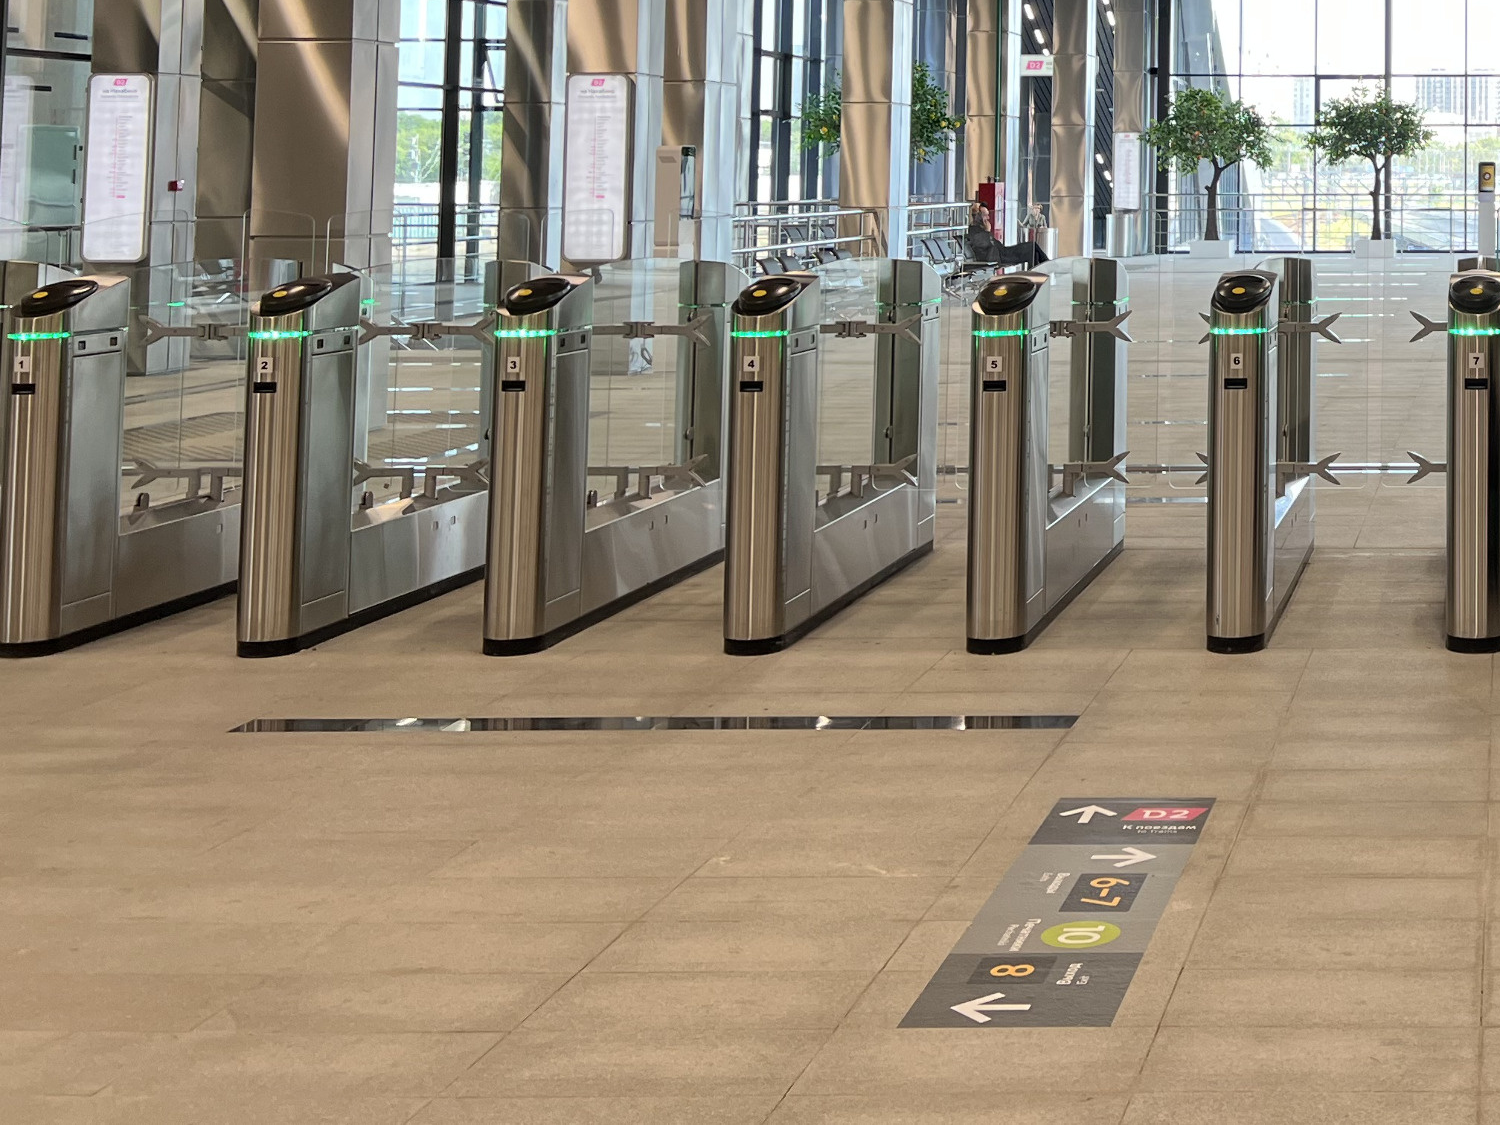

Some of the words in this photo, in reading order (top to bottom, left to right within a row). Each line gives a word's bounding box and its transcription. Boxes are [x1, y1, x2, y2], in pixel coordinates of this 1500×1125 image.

[18, 360, 24, 369] 1
[261, 361, 268, 370] 2
[509, 360, 517, 370] 3
[747, 359, 755, 369] 4
[990, 360, 998, 369] 5
[1233, 356, 1241, 365] 6
[1472, 356, 1480, 365] 7
[1142, 809, 1190, 819] D2
[1057, 925, 1106, 944] 10
[989, 964, 1035, 977] 8
[1056, 962, 1084, 985] Выход
